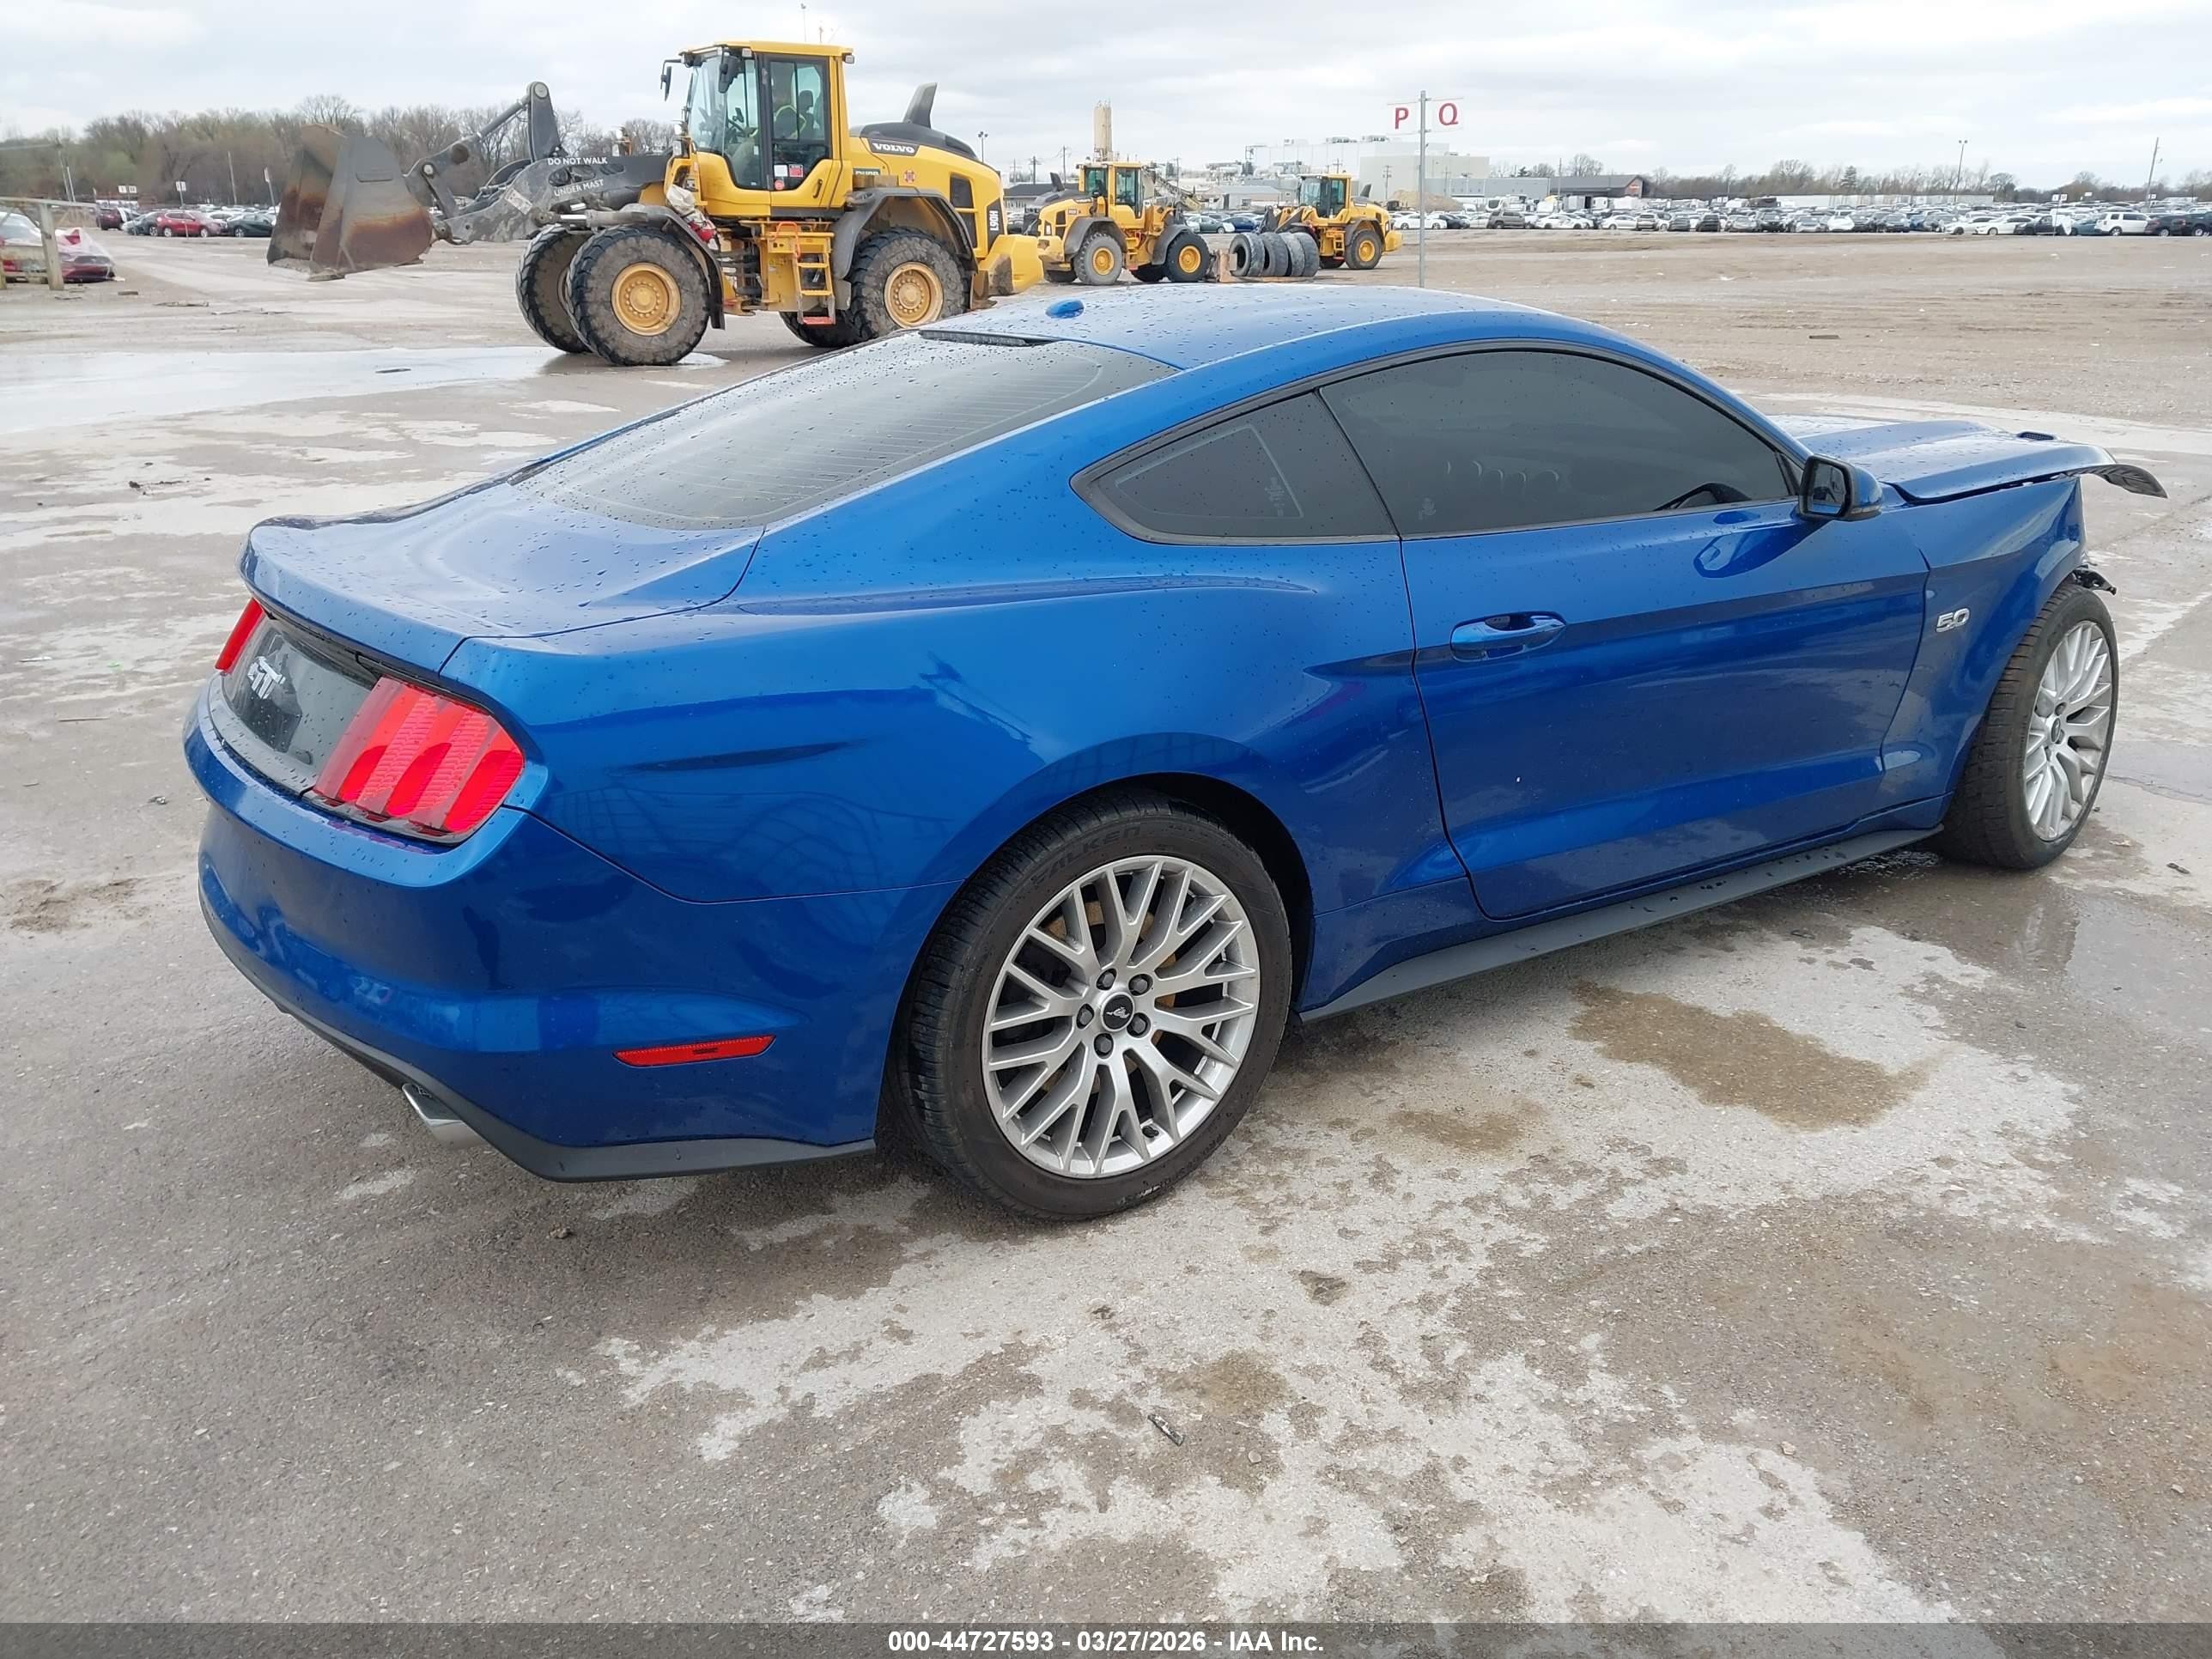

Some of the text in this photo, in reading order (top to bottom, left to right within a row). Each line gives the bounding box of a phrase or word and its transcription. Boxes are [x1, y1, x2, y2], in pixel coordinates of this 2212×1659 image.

[1395, 107, 1409, 130] P
[1438, 103, 1459, 125] Q
[872, 143, 915, 154] VOLVO
[548, 157, 562, 166] DO
[583, 156, 608, 165] WALK
[554, 179, 605, 197] UNDER MAST
[989, 210, 1000, 231] L90H
[247, 656, 286, 699] GT
